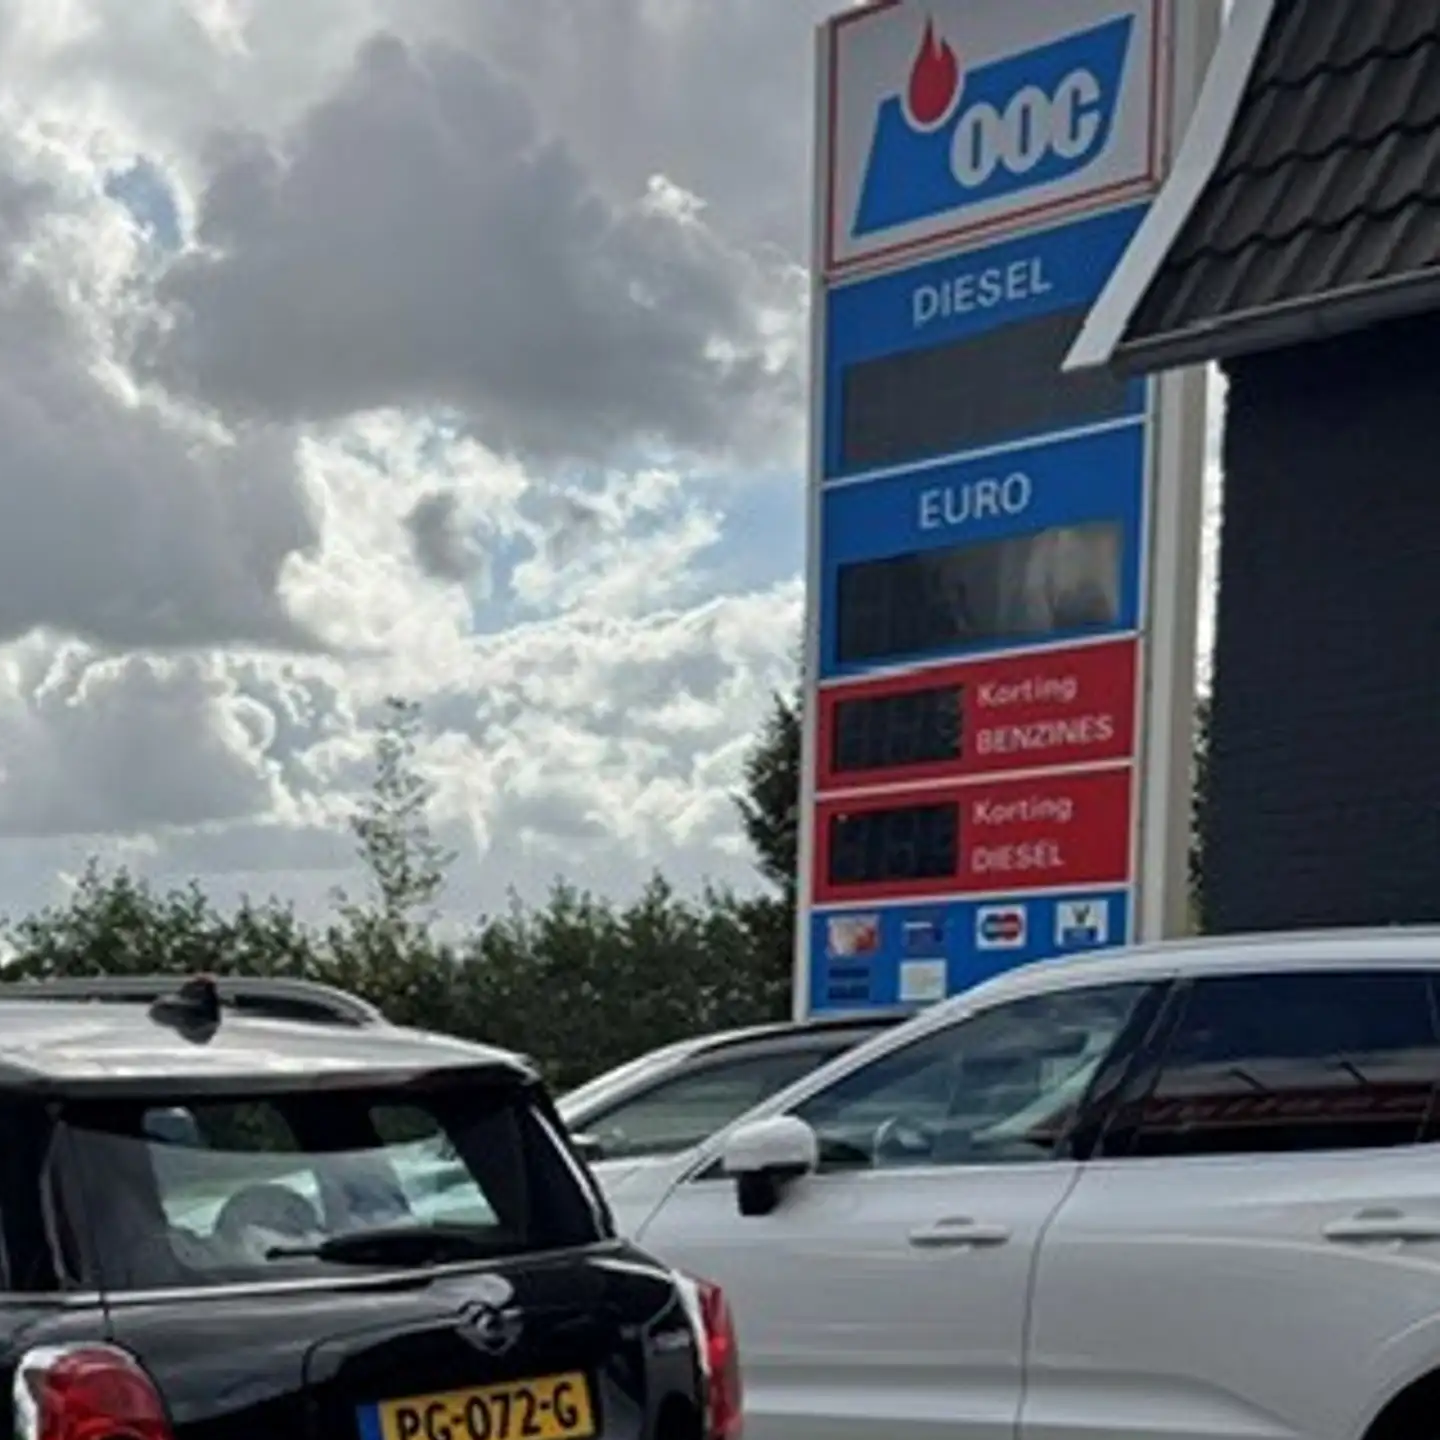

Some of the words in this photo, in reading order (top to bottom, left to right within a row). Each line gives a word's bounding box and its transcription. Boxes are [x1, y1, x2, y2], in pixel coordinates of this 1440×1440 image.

[950, 68, 1101, 188] OOC
[913, 258, 1053, 326] DIESEL
[918, 472, 1032, 529] EURO
[977, 677, 1077, 707] Korting
[976, 716, 1113, 754] BENZINES
[973, 797, 1073, 823] Korting
[971, 840, 1062, 872] DIESEL
